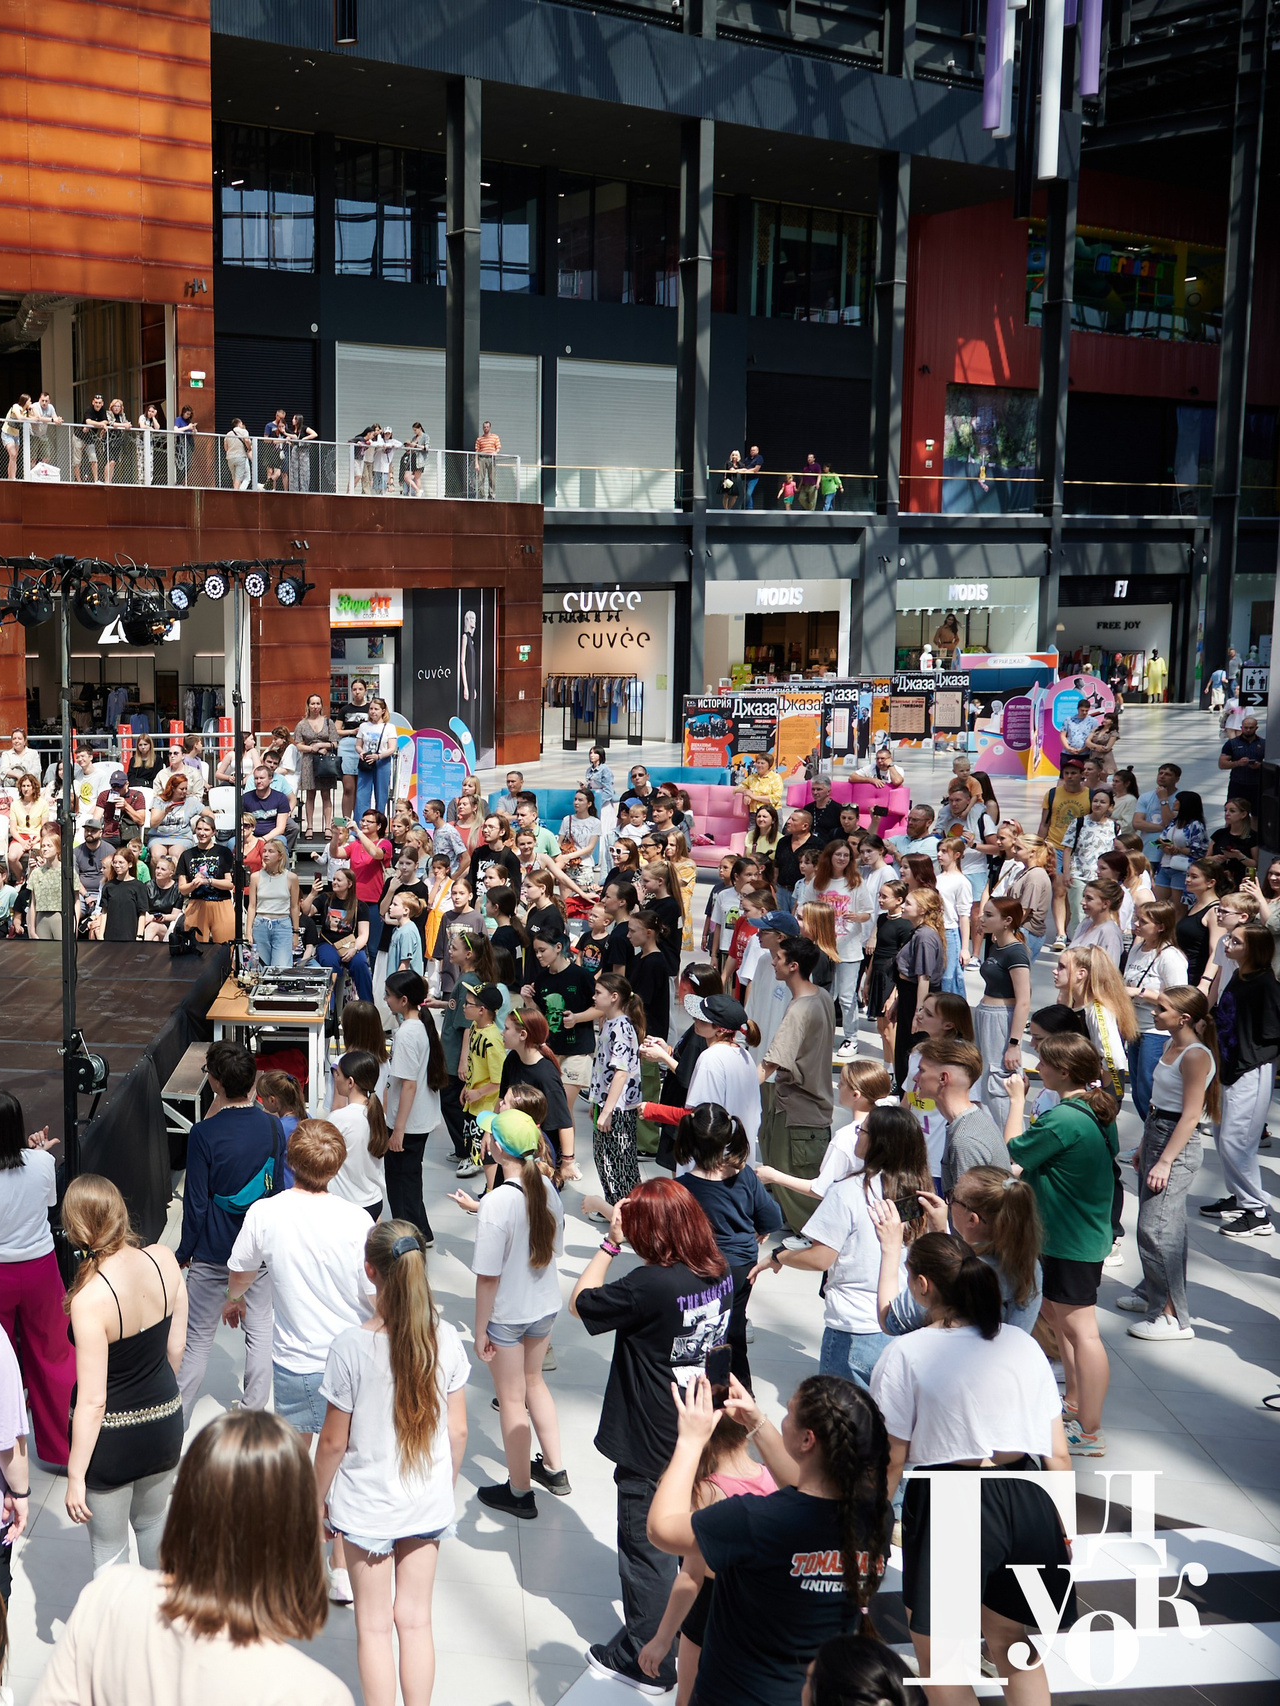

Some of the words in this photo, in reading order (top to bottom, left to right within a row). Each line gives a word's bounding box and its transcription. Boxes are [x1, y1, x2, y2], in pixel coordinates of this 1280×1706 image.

[756, 587, 804, 606] MODIS
[949, 583, 989, 601] MODIS
[1096, 621, 1121, 630] FREE
[1124, 621, 1141, 630] JOY
[897, 675, 934, 692] Джаза
[697, 698, 732, 709] ИСТОРИЯ
[732, 698, 777, 718] Джаза
